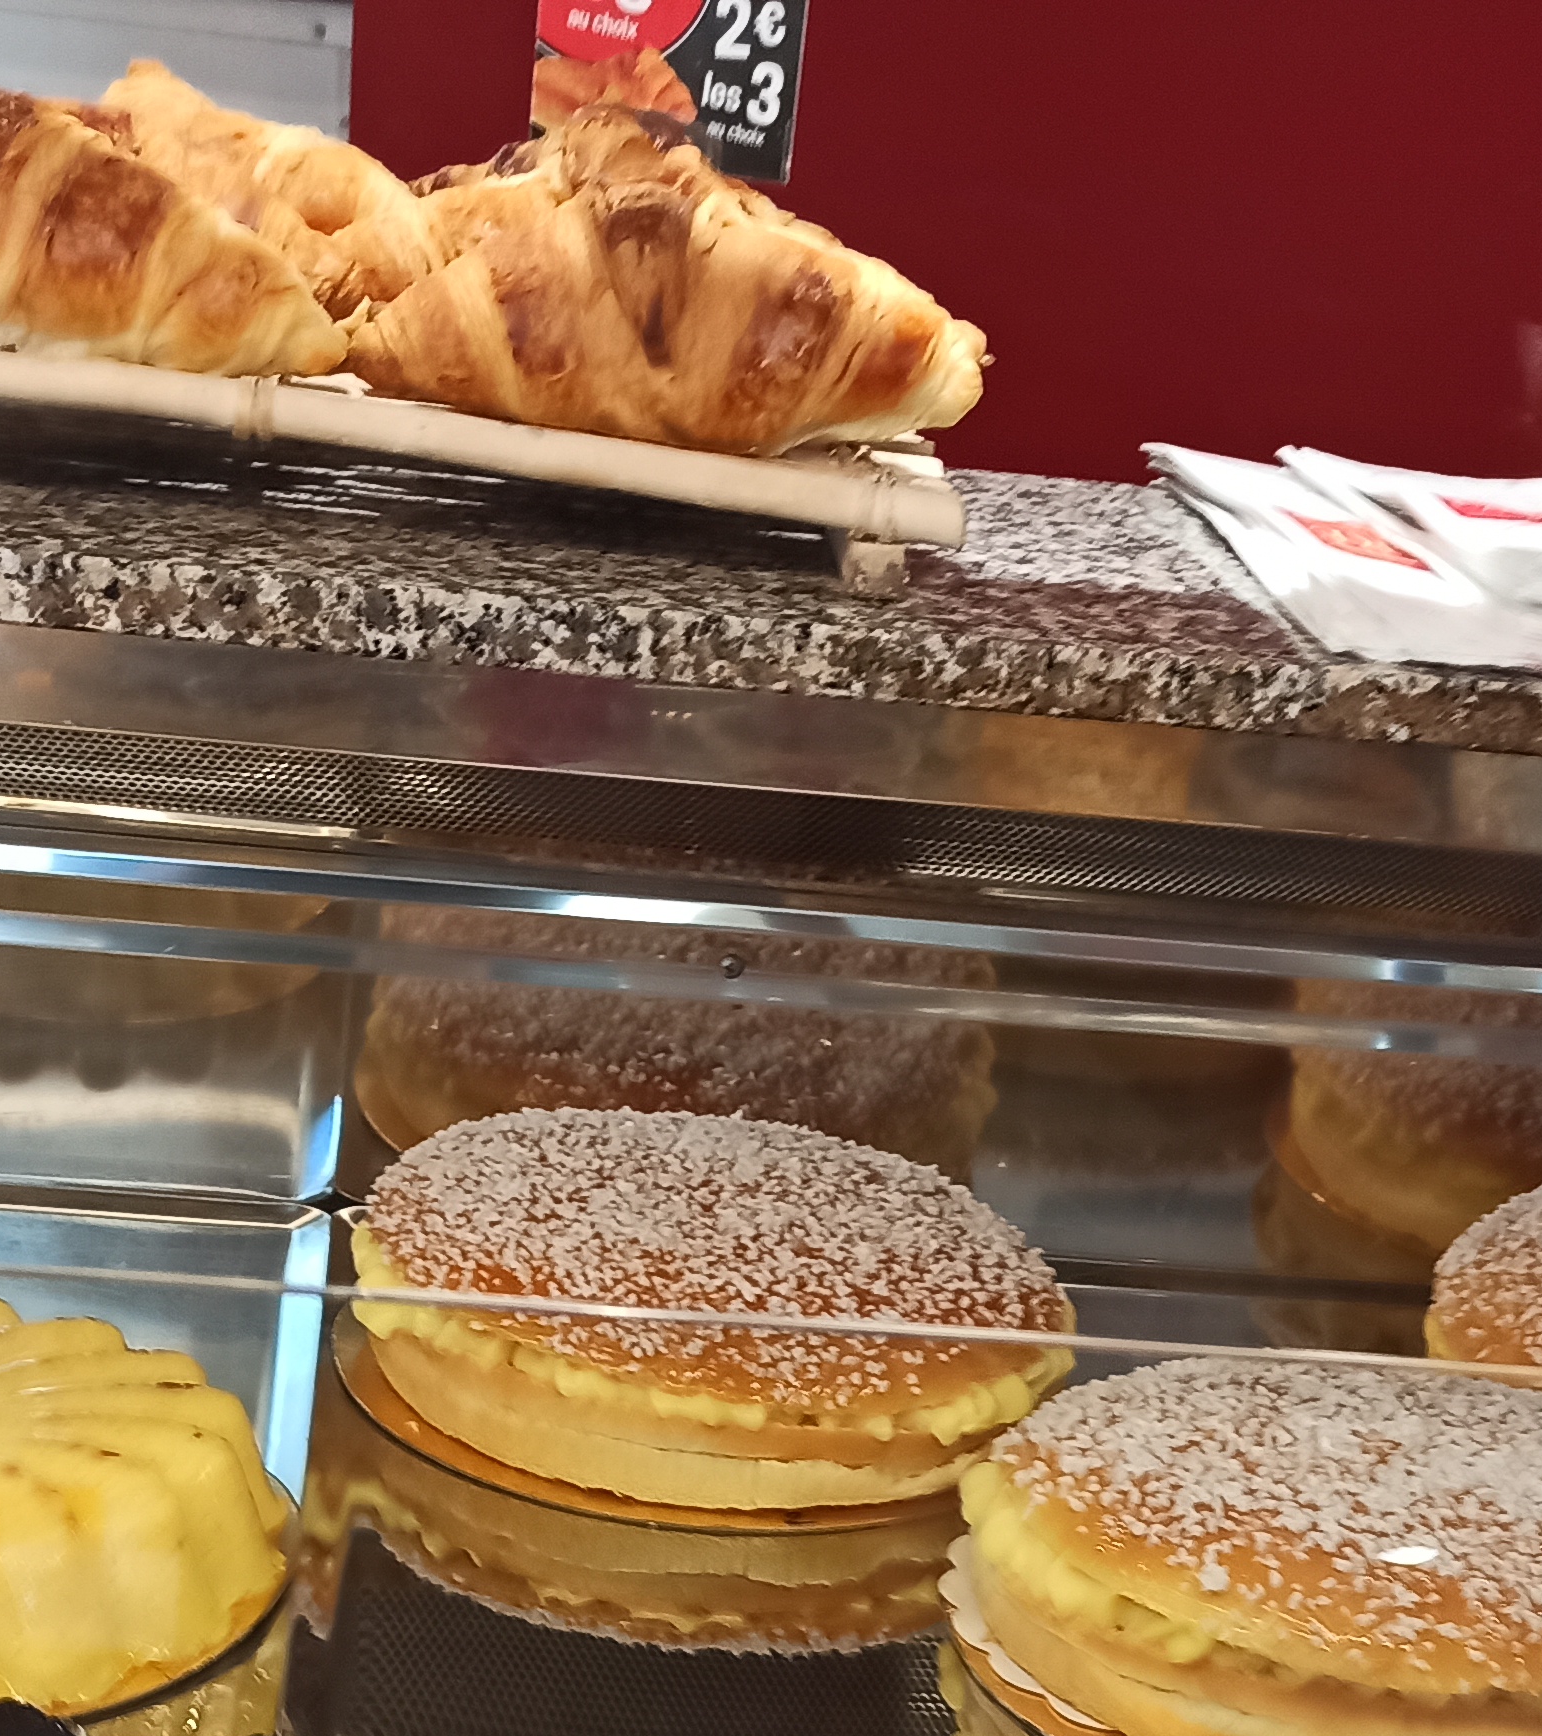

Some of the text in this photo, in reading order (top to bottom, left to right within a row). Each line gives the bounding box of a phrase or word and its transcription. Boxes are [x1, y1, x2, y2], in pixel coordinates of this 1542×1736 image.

[566, 7, 590, 31] au
[591, 11, 639, 42] choix
[745, 61, 785, 127] 3
